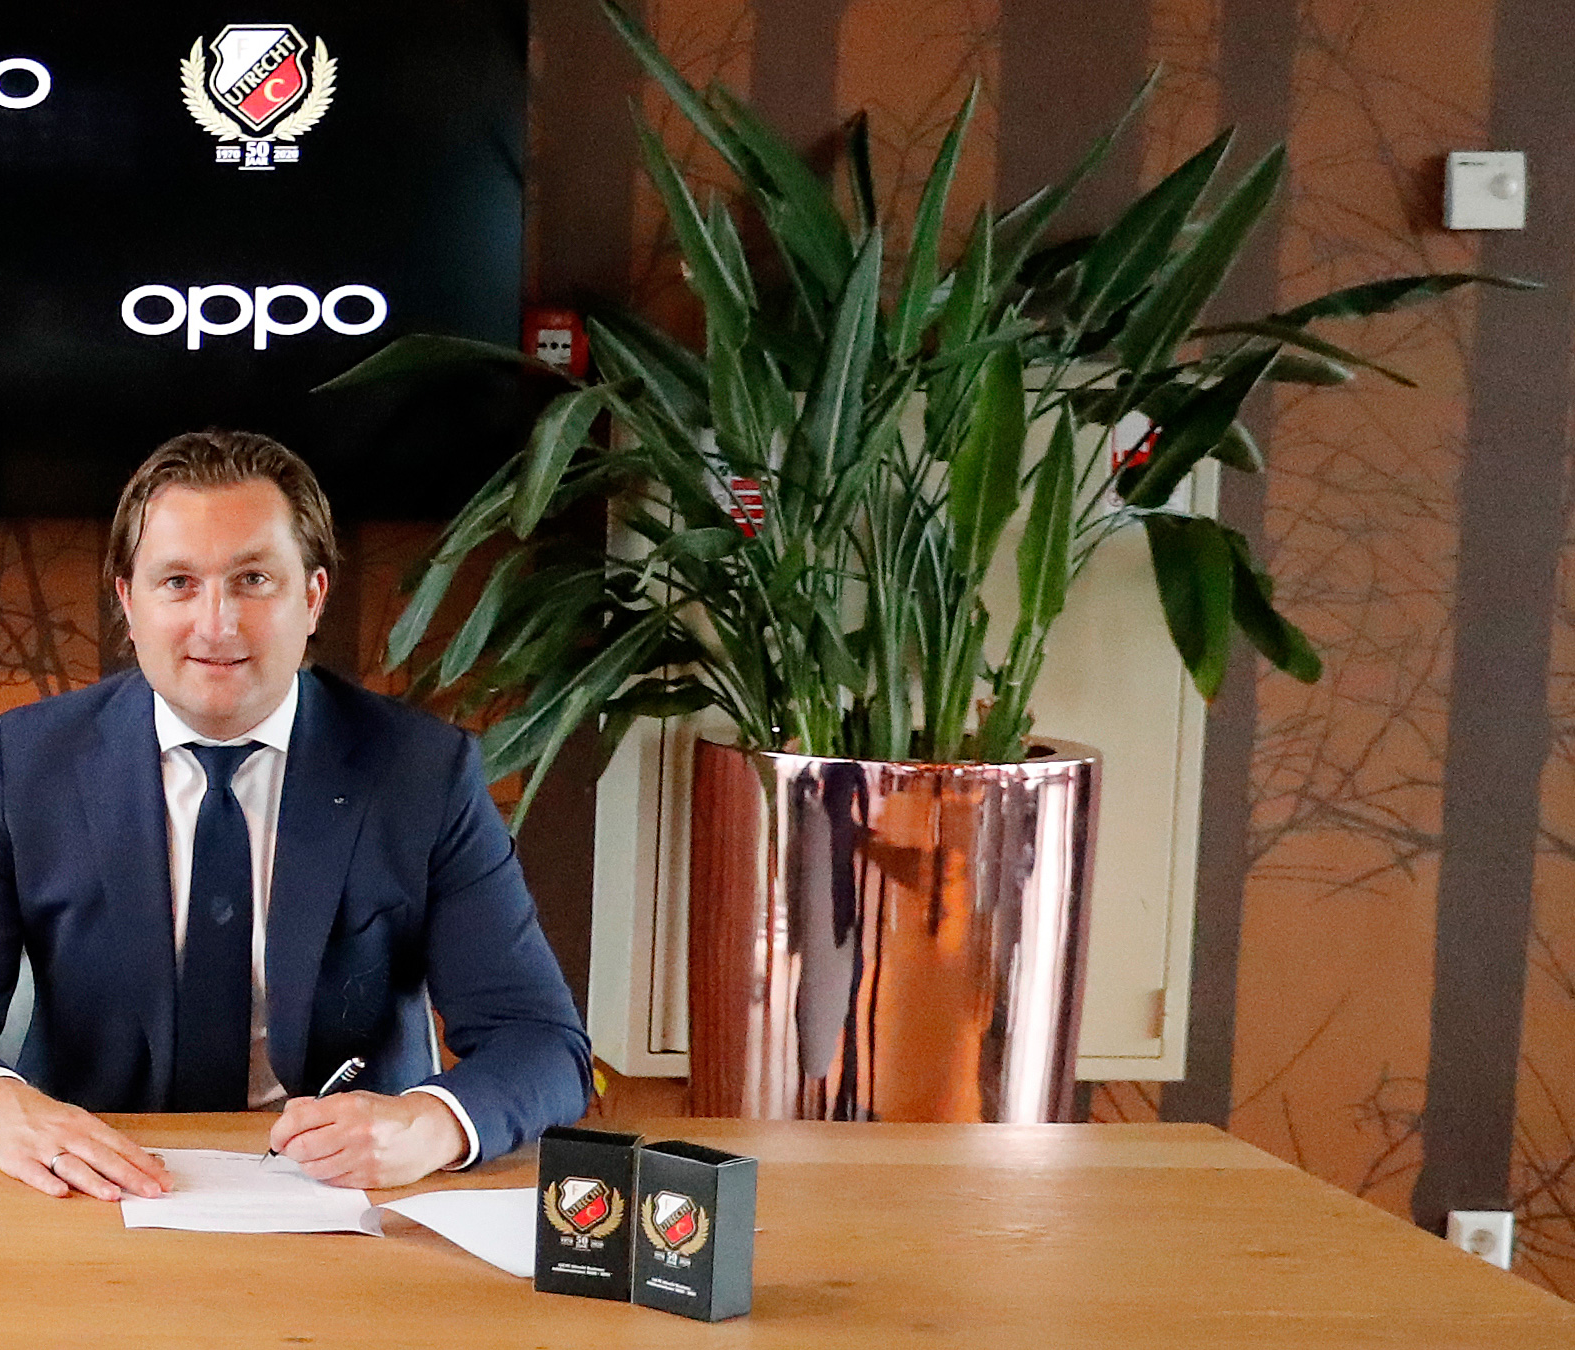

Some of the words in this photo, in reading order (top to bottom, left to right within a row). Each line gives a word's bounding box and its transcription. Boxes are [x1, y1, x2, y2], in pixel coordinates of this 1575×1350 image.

[224, 34, 296, 105] UTRECHT
[263, 78, 285, 102] C
[215, 150, 241, 159] 1970
[245, 141, 270, 157] 50
[273, 150, 299, 159] 2020
[121, 284, 388, 351] oppo
